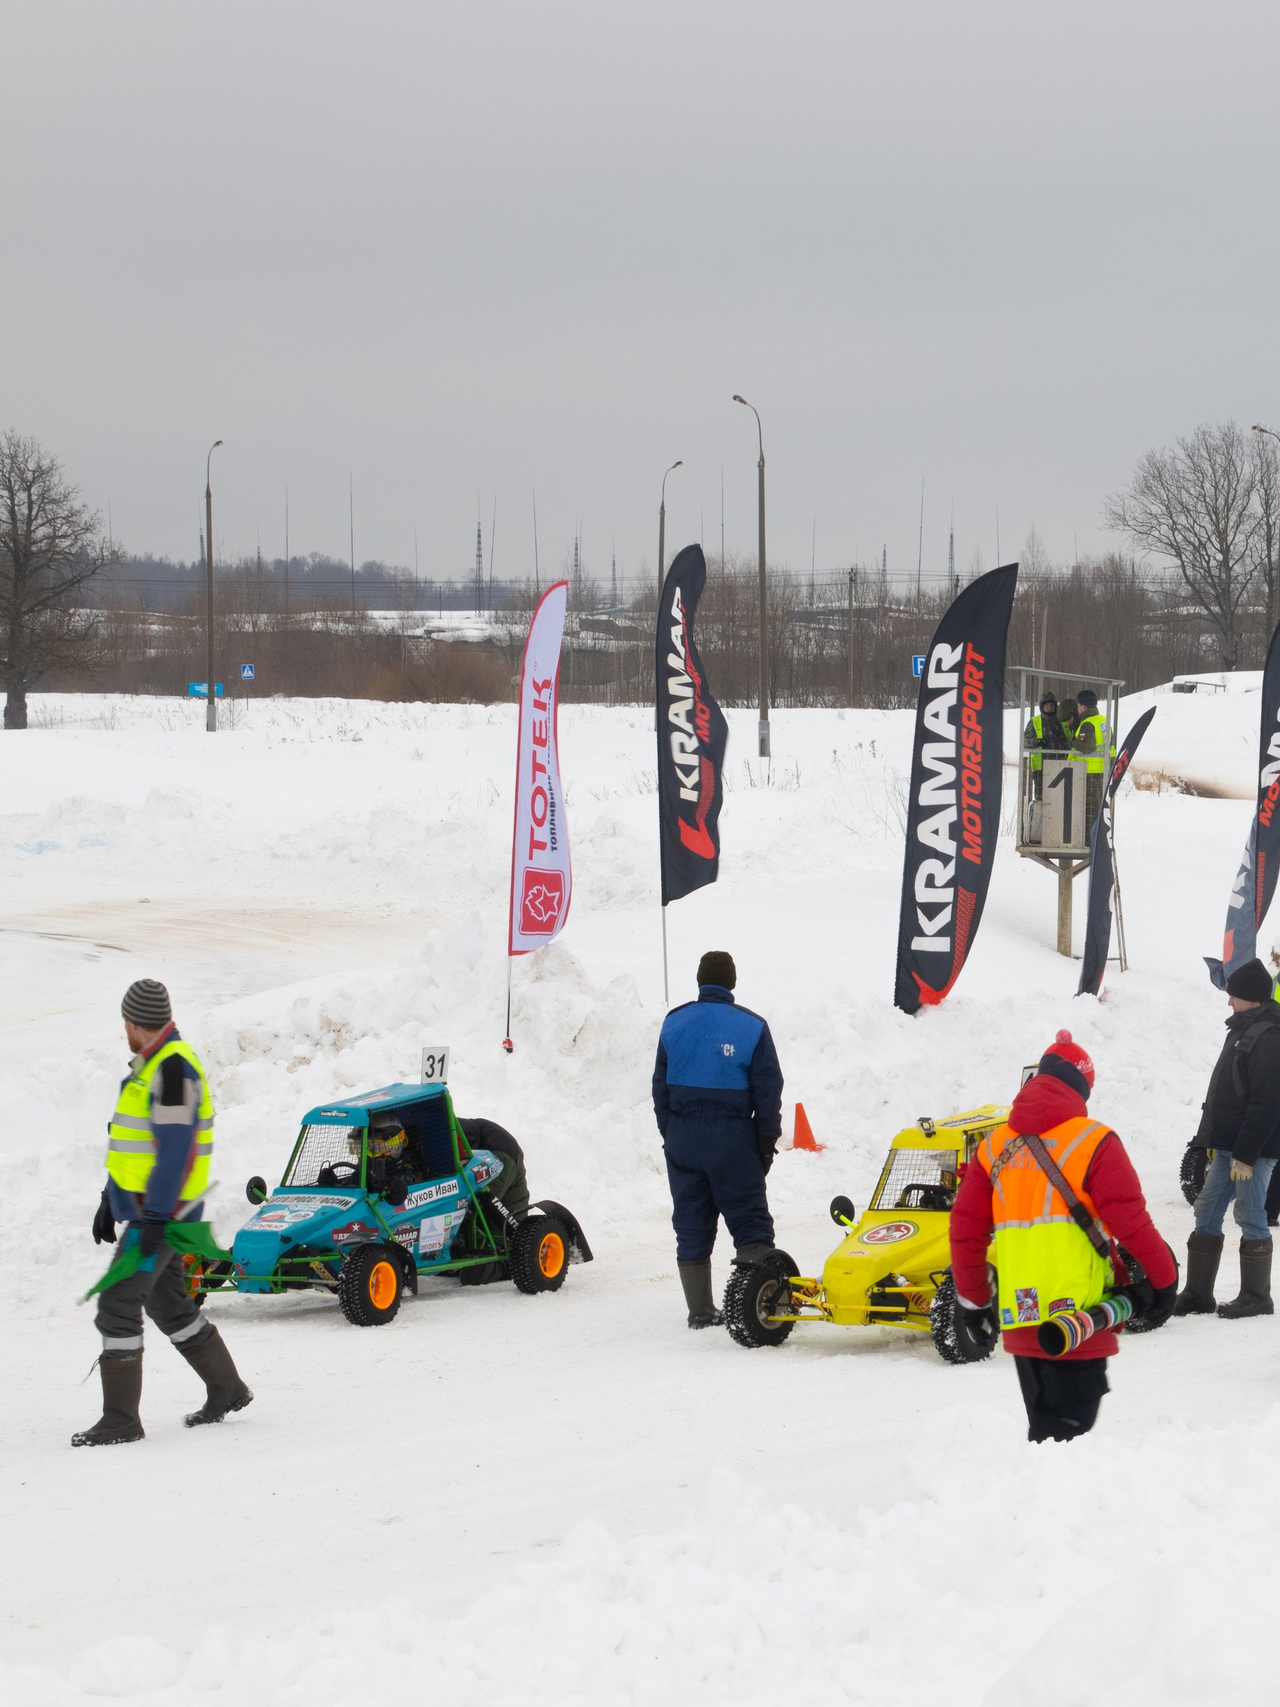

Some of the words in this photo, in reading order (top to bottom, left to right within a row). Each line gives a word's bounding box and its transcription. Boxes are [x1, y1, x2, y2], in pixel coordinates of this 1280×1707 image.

[961, 642, 986, 865] MOTORSPORT
[912, 642, 964, 953] KRAMAR
[1047, 767, 1073, 844] 1
[425, 1053, 446, 1079] 31
[406, 1190, 434, 1208] Жуков
[434, 1182, 458, 1197] Иван
[389, 1231, 418, 1243] RAMAR
